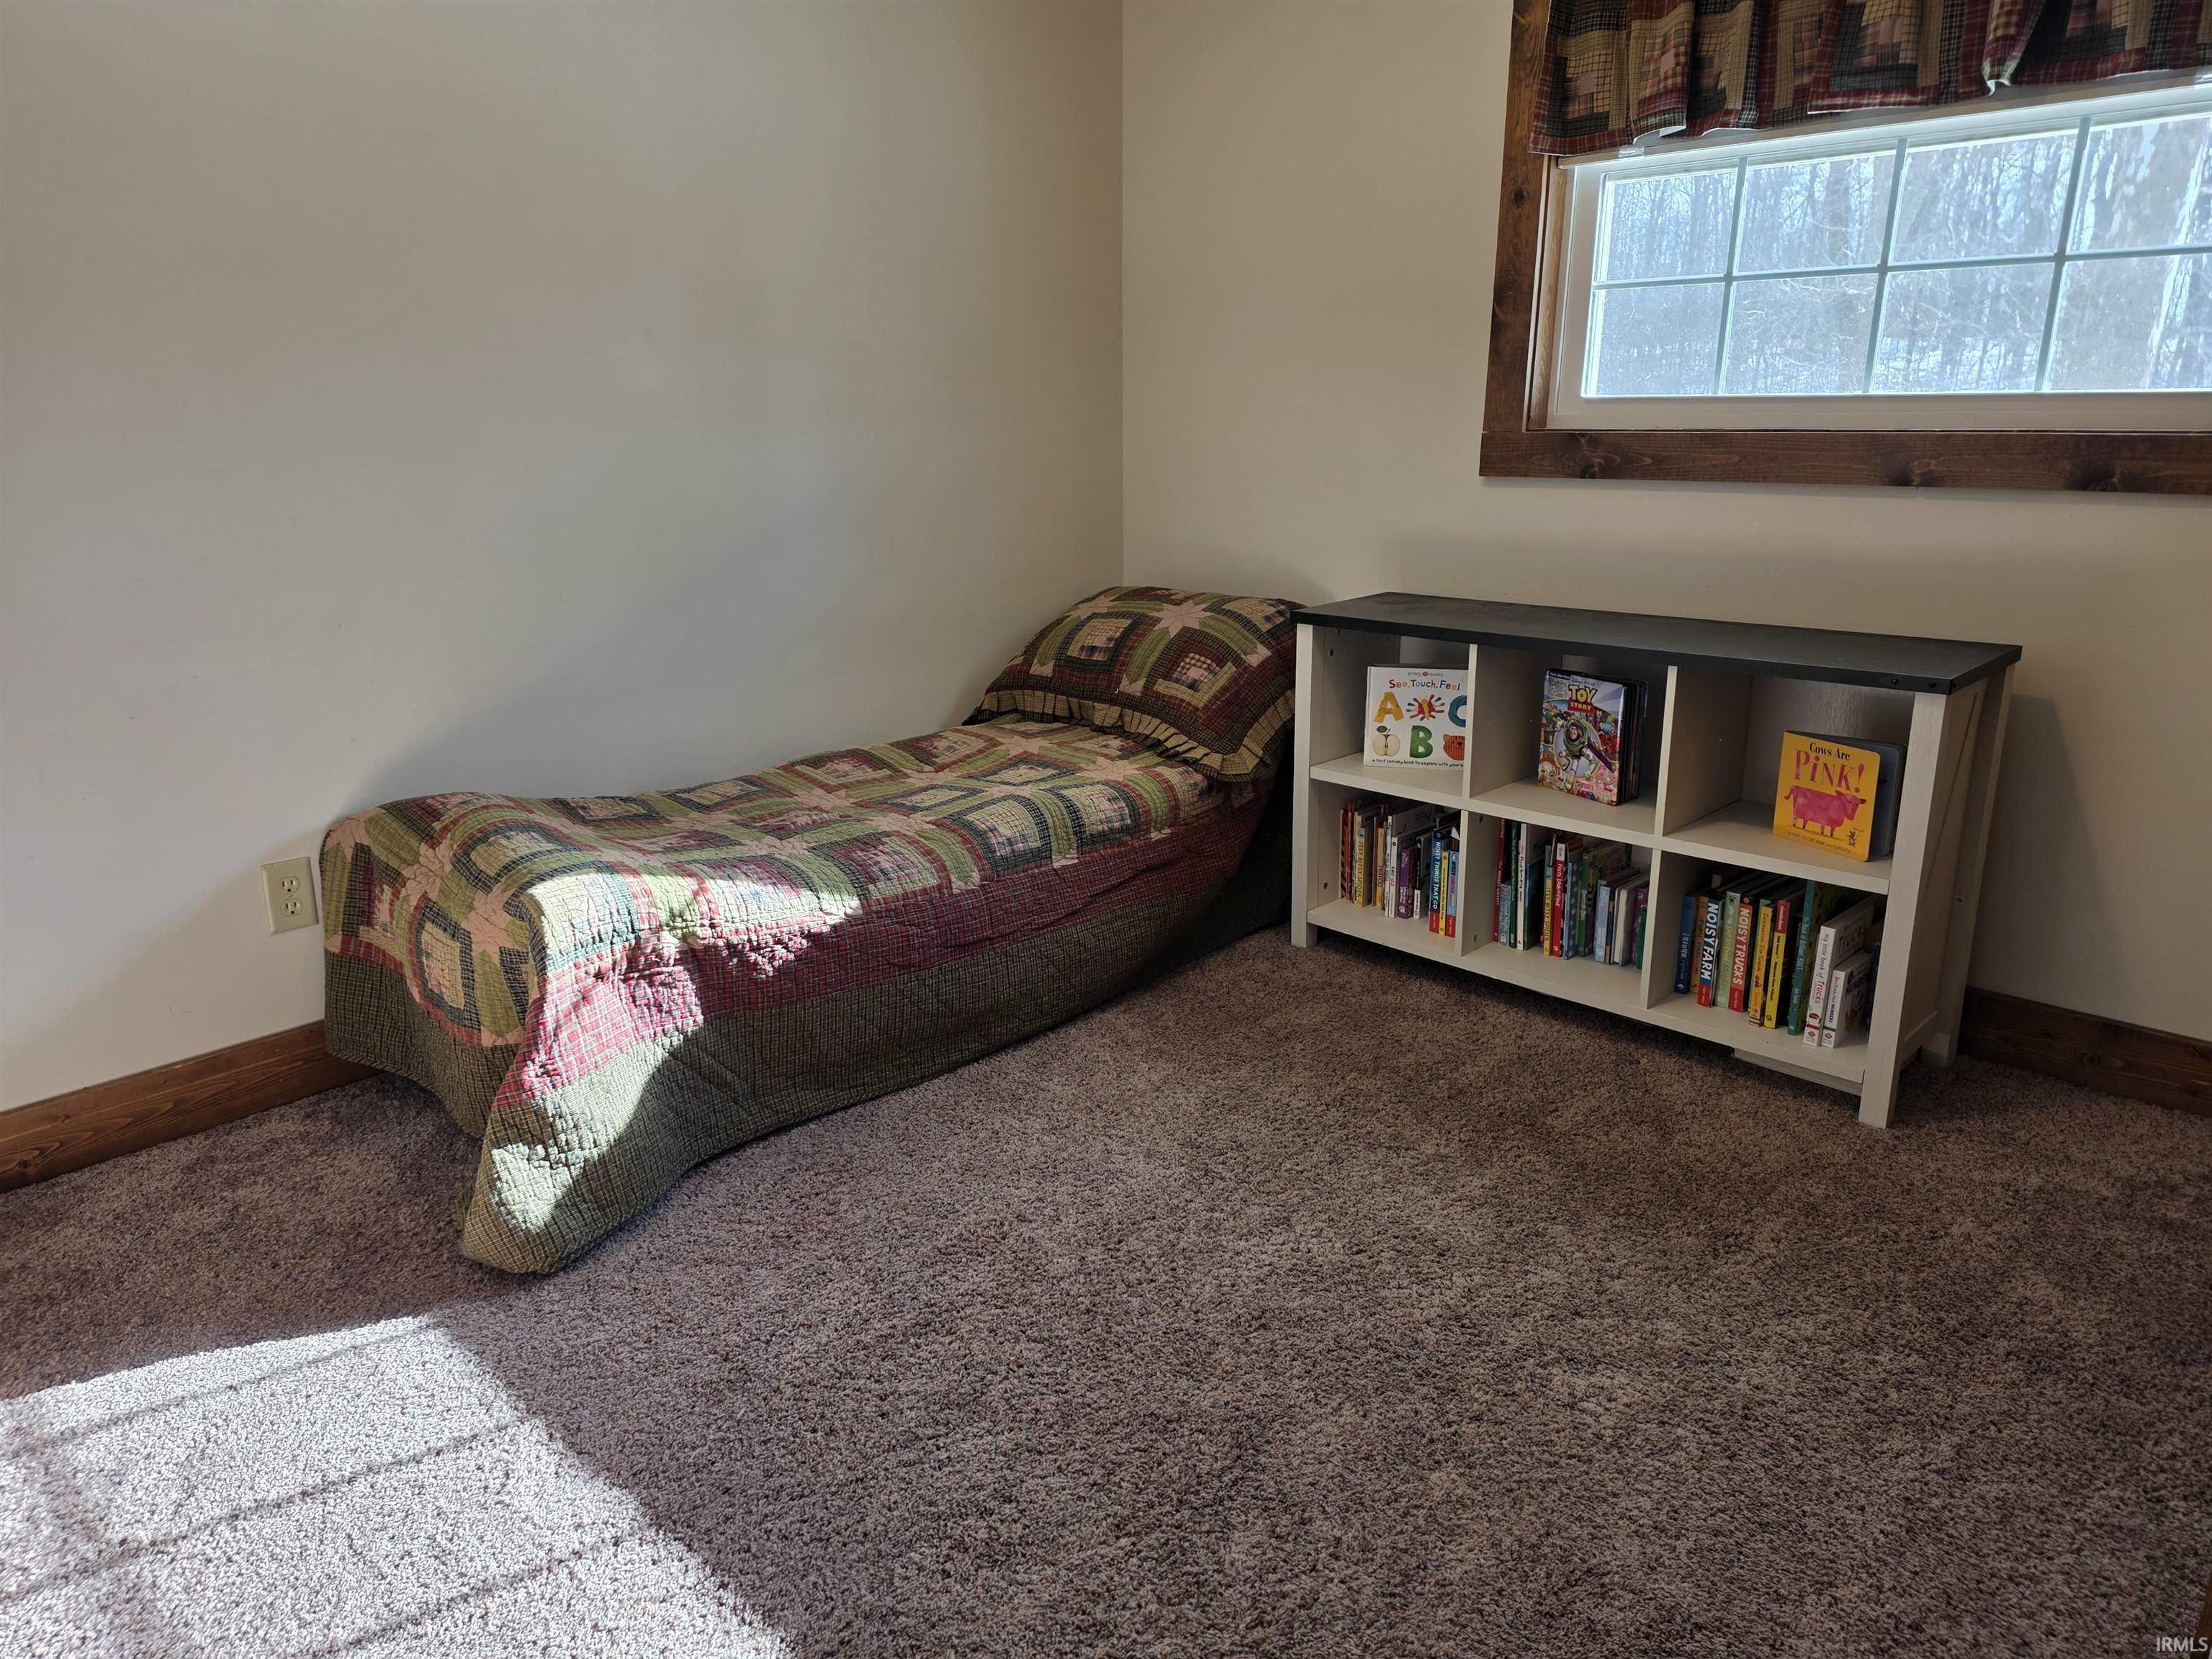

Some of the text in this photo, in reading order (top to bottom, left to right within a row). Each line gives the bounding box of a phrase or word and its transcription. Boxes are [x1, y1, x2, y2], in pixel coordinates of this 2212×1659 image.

[1439, 680, 1461, 691] Feel
[1568, 684, 1598, 703] TOY
[1373, 691, 1404, 724] A
[1570, 701, 1591, 711] STORY
[1409, 725, 1434, 758] B
[1809, 742, 1851, 760] Cows Are
[1704, 902, 1719, 946] NOISY
[1732, 907, 1750, 986] NOISY TRUCKS
[1822, 933, 1829, 943] my
[1700, 945, 1714, 980] FARM
